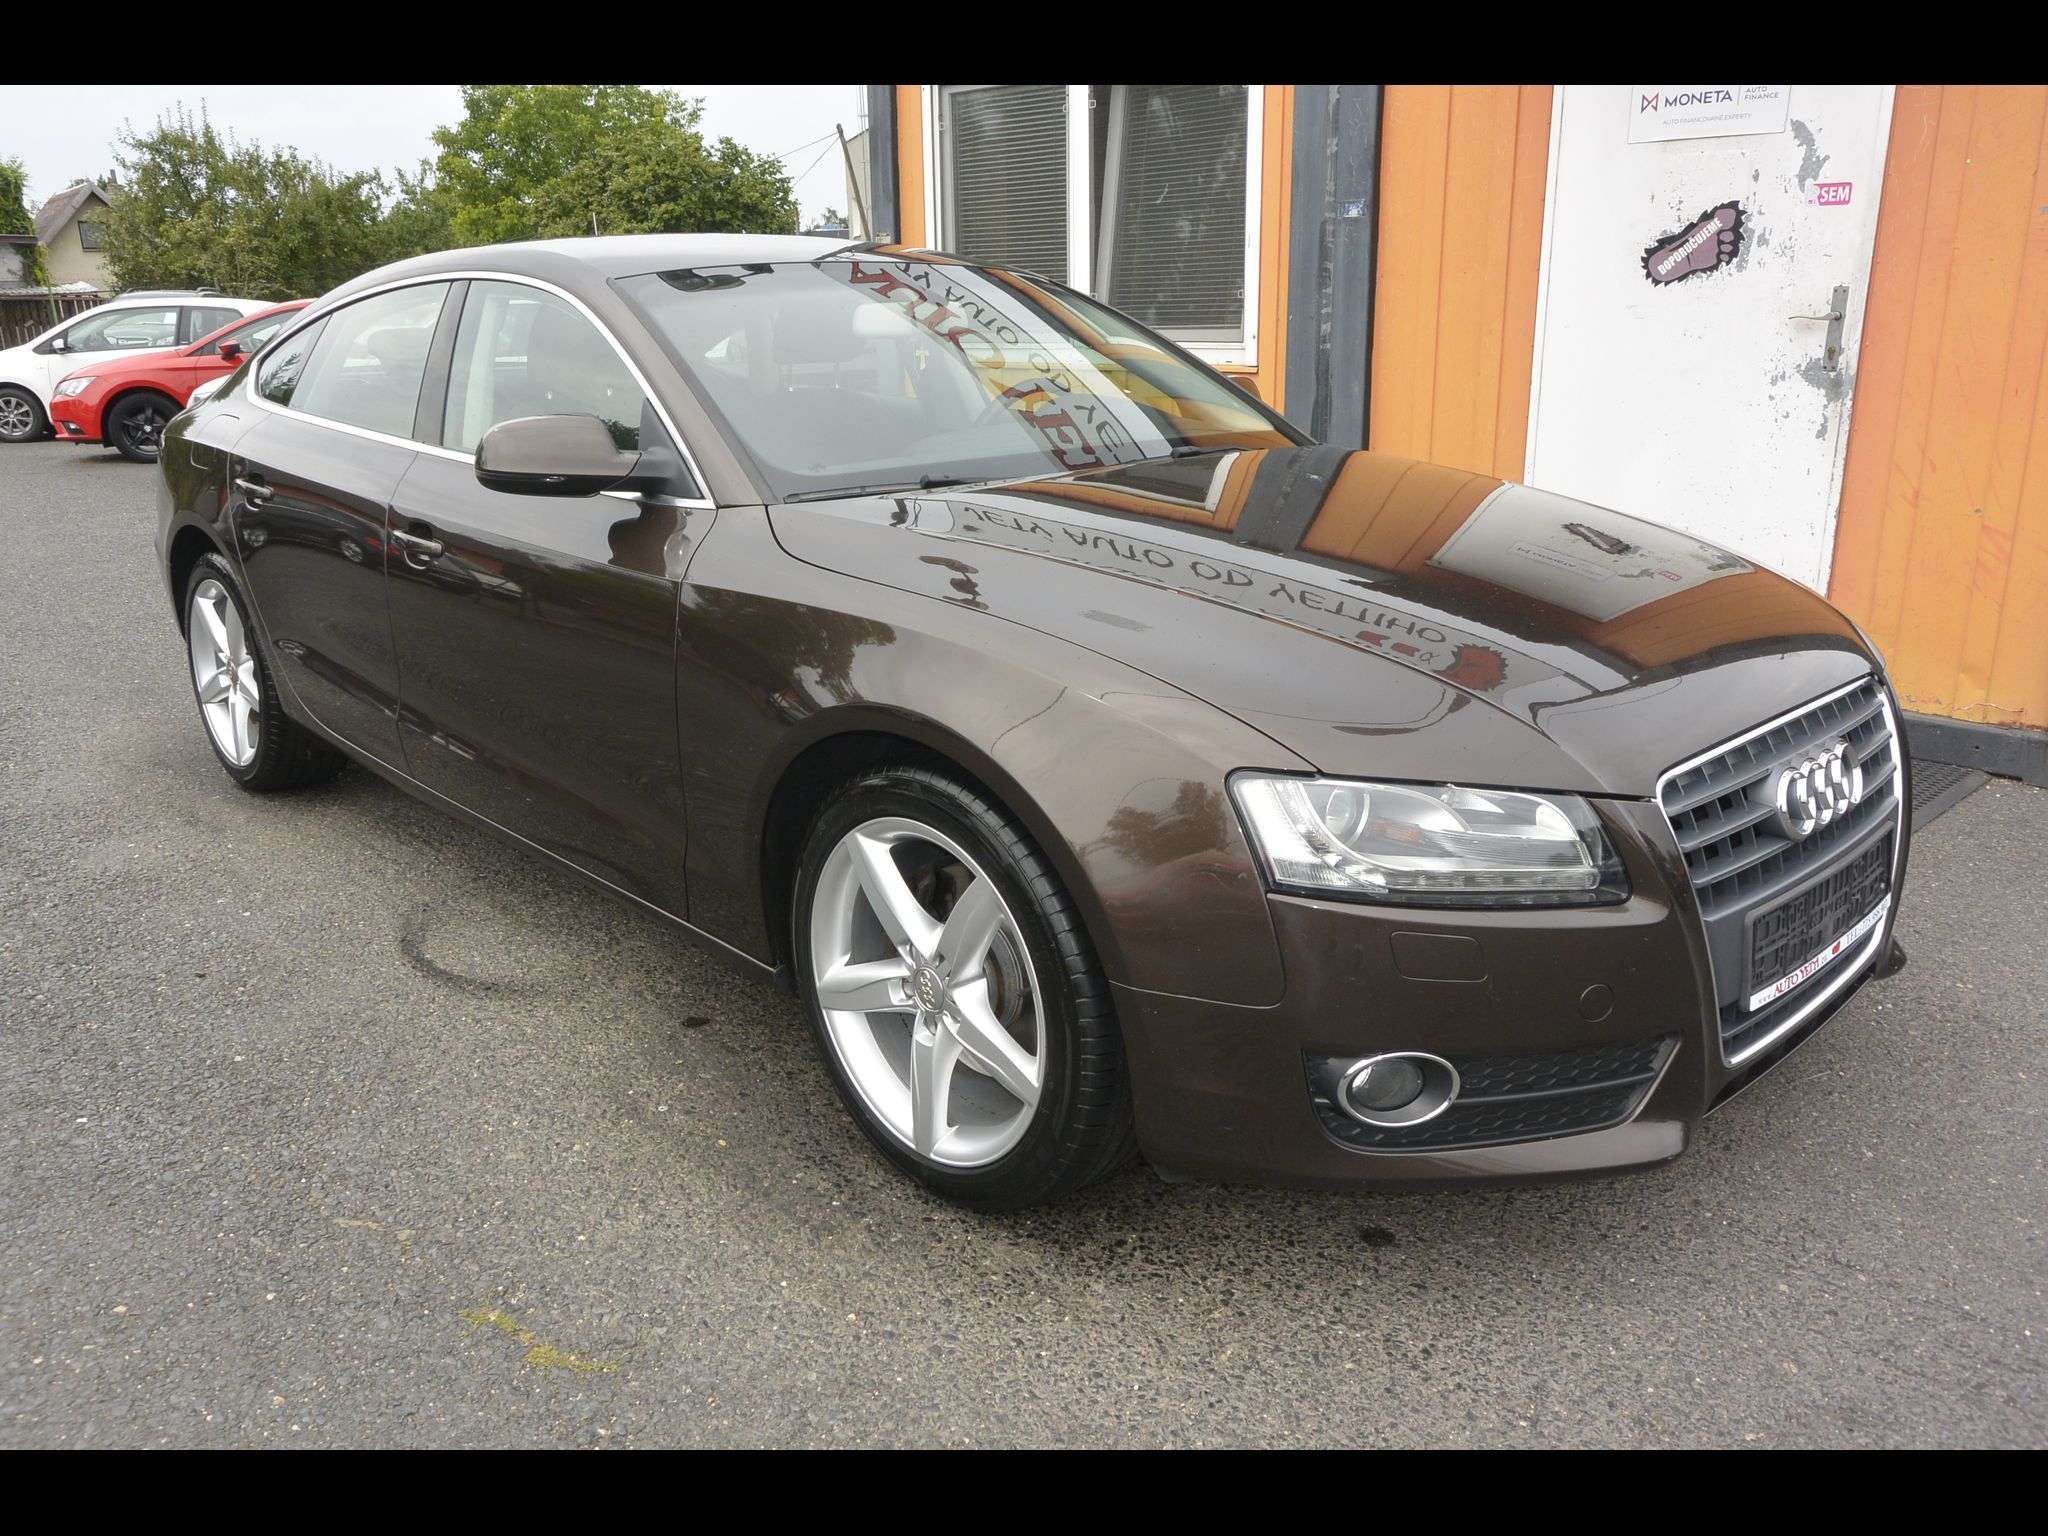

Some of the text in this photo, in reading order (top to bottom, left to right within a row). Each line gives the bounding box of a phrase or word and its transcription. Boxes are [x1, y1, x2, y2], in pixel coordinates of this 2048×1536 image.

[1664, 90, 1733, 107] MONETA
[1744, 92, 1779, 100] FINANCE
[1820, 186, 1850, 202] SEM
[1657, 218, 1723, 275] DOPORUČUJEME
